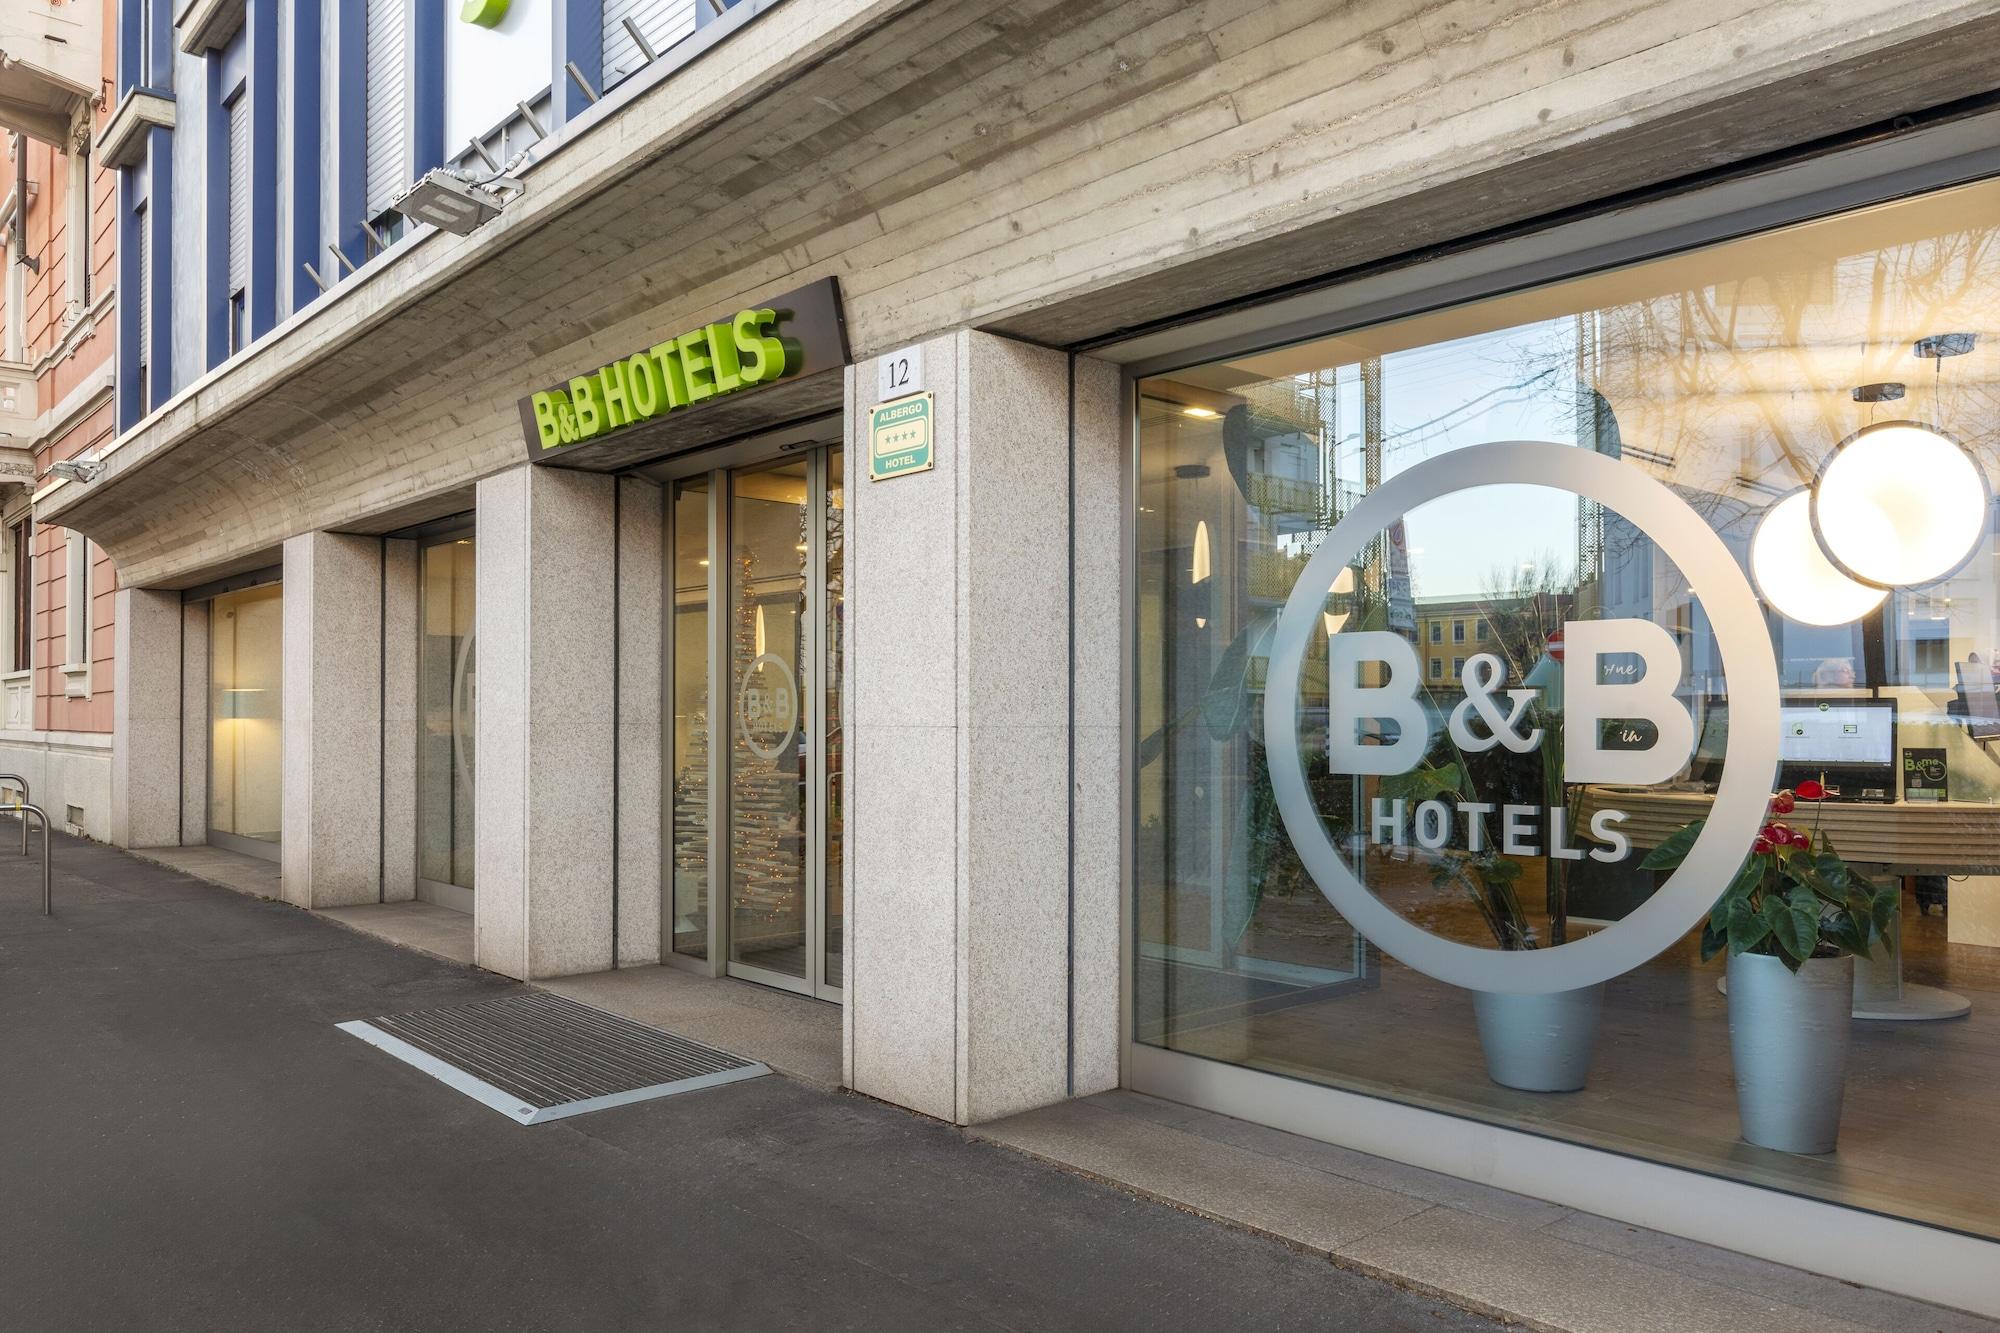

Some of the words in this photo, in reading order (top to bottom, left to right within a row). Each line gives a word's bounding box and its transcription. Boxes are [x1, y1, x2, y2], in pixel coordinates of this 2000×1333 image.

[531, 375, 607, 450] B&B
[599, 308, 786, 428] HOTELS
[888, 358, 910, 389] 12
[879, 403, 923, 423] ALBERGO
[885, 455, 916, 469] HOTEL
[1371, 797, 1632, 864] HOTELS
